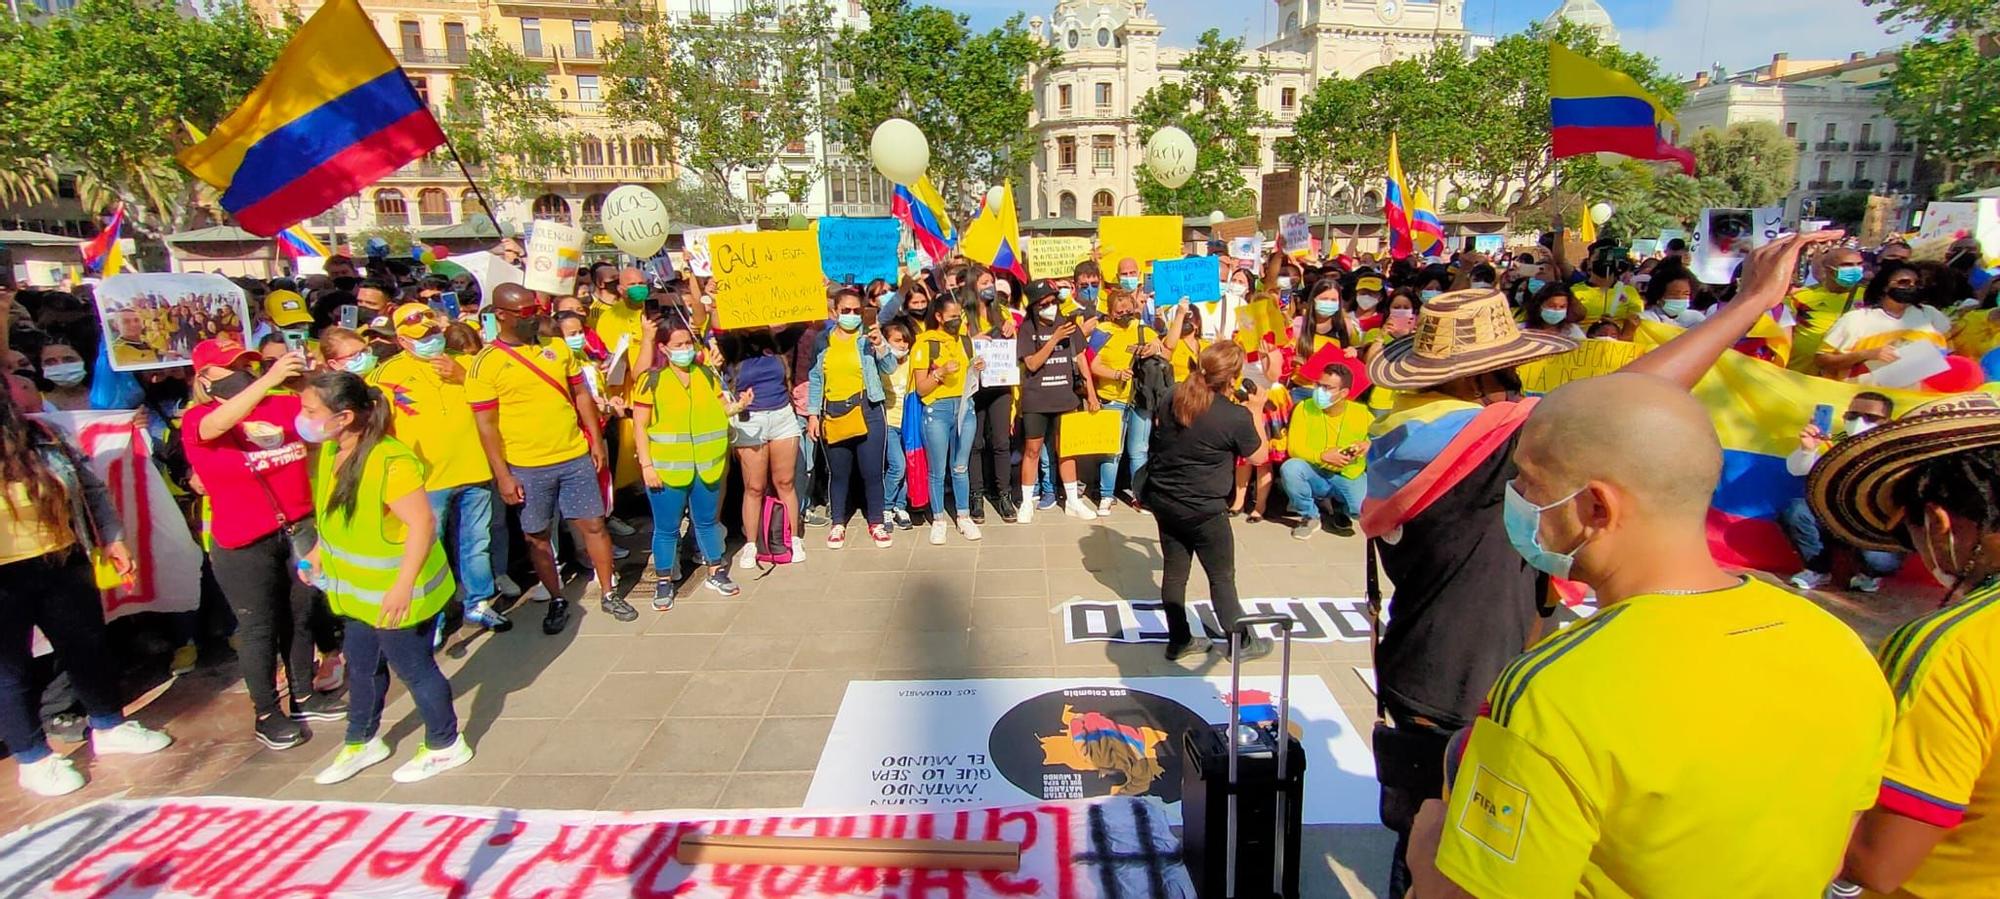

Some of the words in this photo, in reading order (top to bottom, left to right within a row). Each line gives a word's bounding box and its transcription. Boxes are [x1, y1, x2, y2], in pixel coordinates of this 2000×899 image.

[1526, 366, 1547, 391] LA
[1063, 689, 1108, 698] Colombia
[1109, 689, 1127, 697] SOS
[881, 754, 958, 768] MUNDO
[967, 753, 986, 766] EL
[871, 768, 912, 782] SEPA
[921, 768, 945, 782] LO
[956, 768, 992, 782] QUE
[881, 782, 978, 796] MATANDO
[1472, 791, 1497, 817] FIFA
